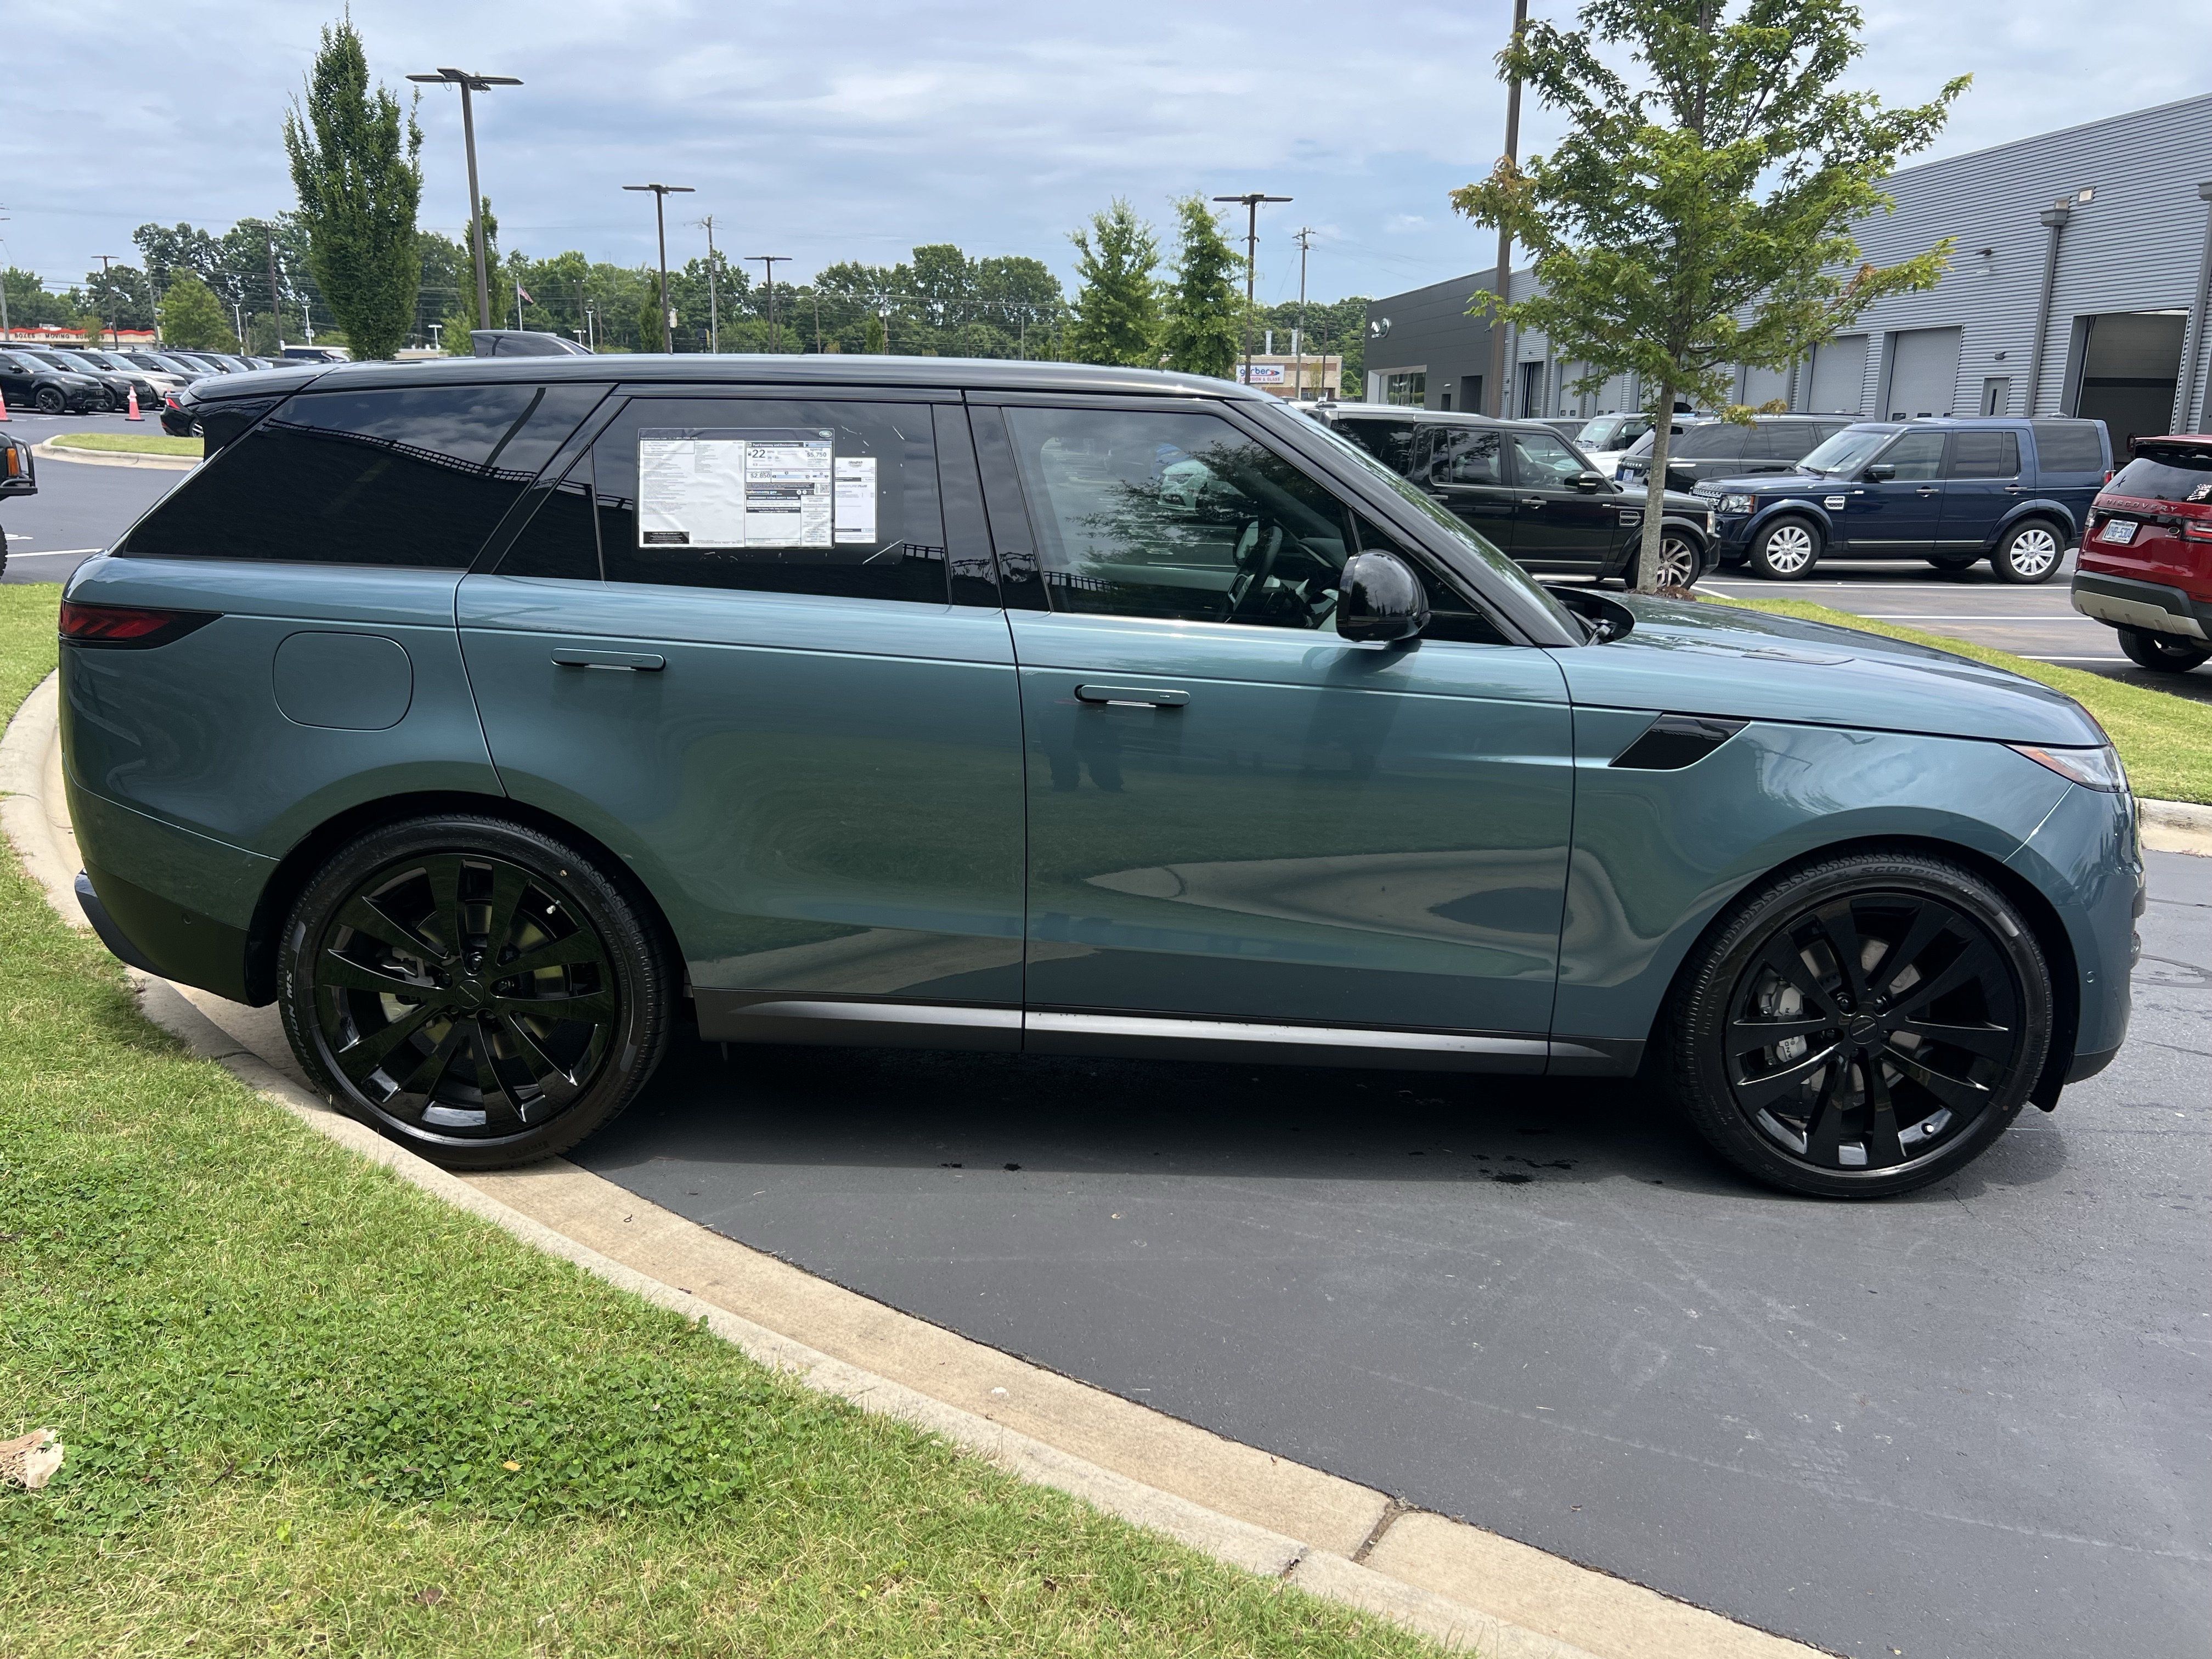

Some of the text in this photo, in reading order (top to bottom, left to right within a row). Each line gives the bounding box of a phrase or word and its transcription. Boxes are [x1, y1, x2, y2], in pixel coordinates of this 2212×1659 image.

[1240, 367, 1269, 376] grber
[752, 449, 765, 458] 22
[2107, 499, 2178, 512] DISCOVERY
[1860, 866, 1955, 885] SCORPION
[287, 1004, 323, 1082] CORPION
[1785, 1041, 1793, 1058] AND
